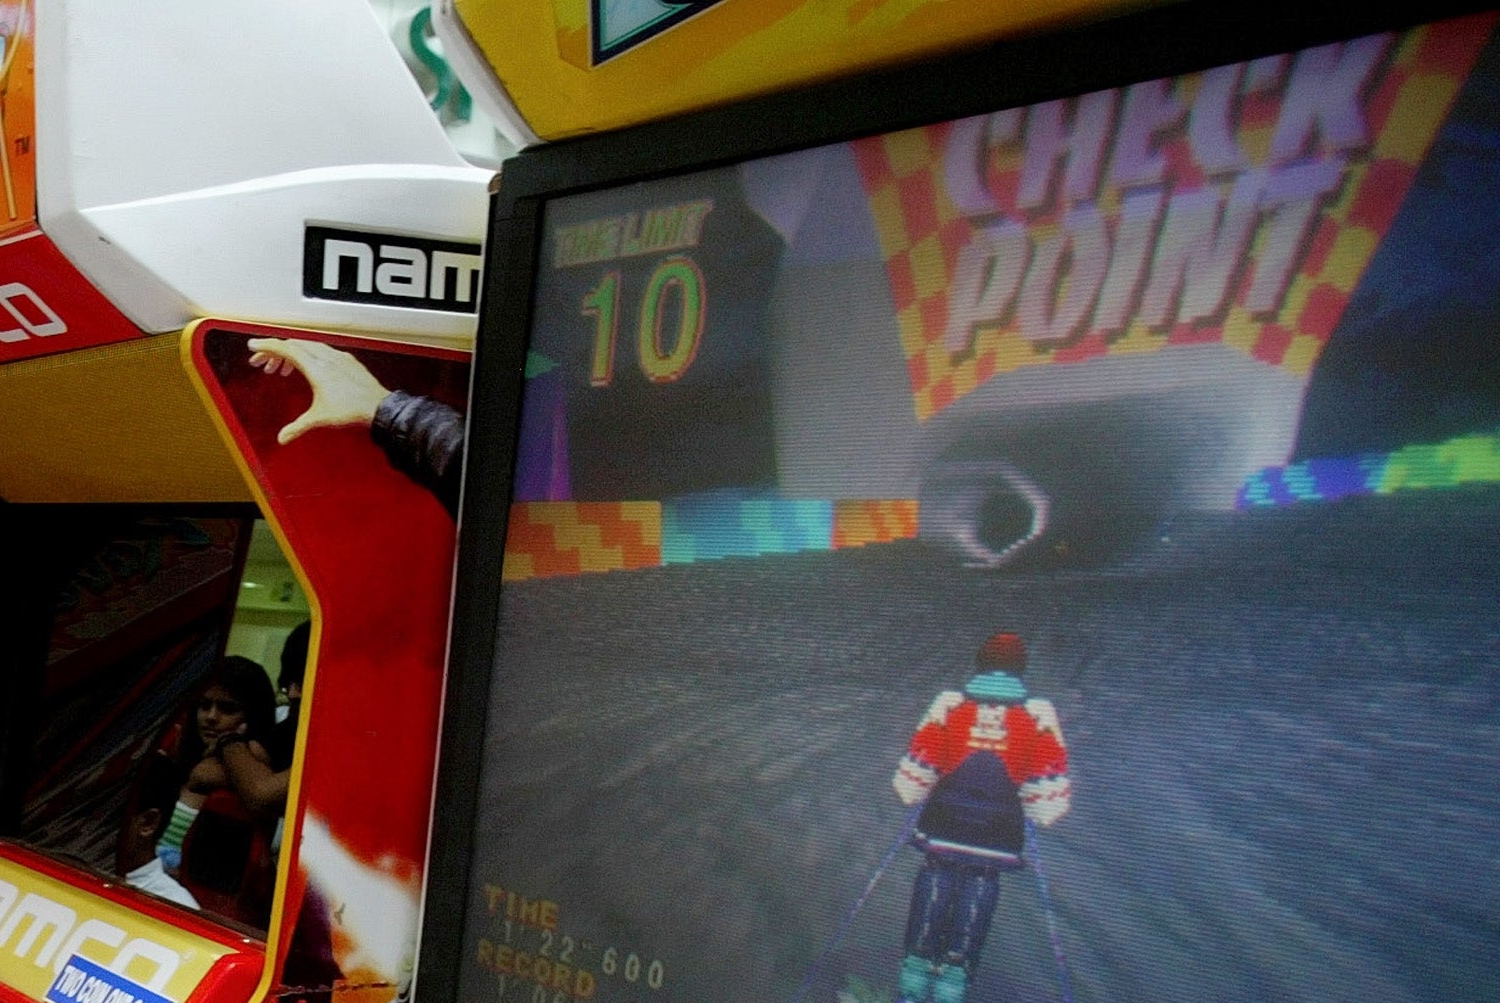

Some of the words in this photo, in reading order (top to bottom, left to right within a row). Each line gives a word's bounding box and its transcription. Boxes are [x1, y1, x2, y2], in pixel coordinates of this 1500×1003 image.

[943, 31, 1396, 220] CHECK
[944, 158, 1348, 364] POINT
[581, 254, 708, 388] 10
[484, 884, 559, 932] TIME
[54, 964, 88, 998] TWO
[477, 938, 596, 1000] RECORD
